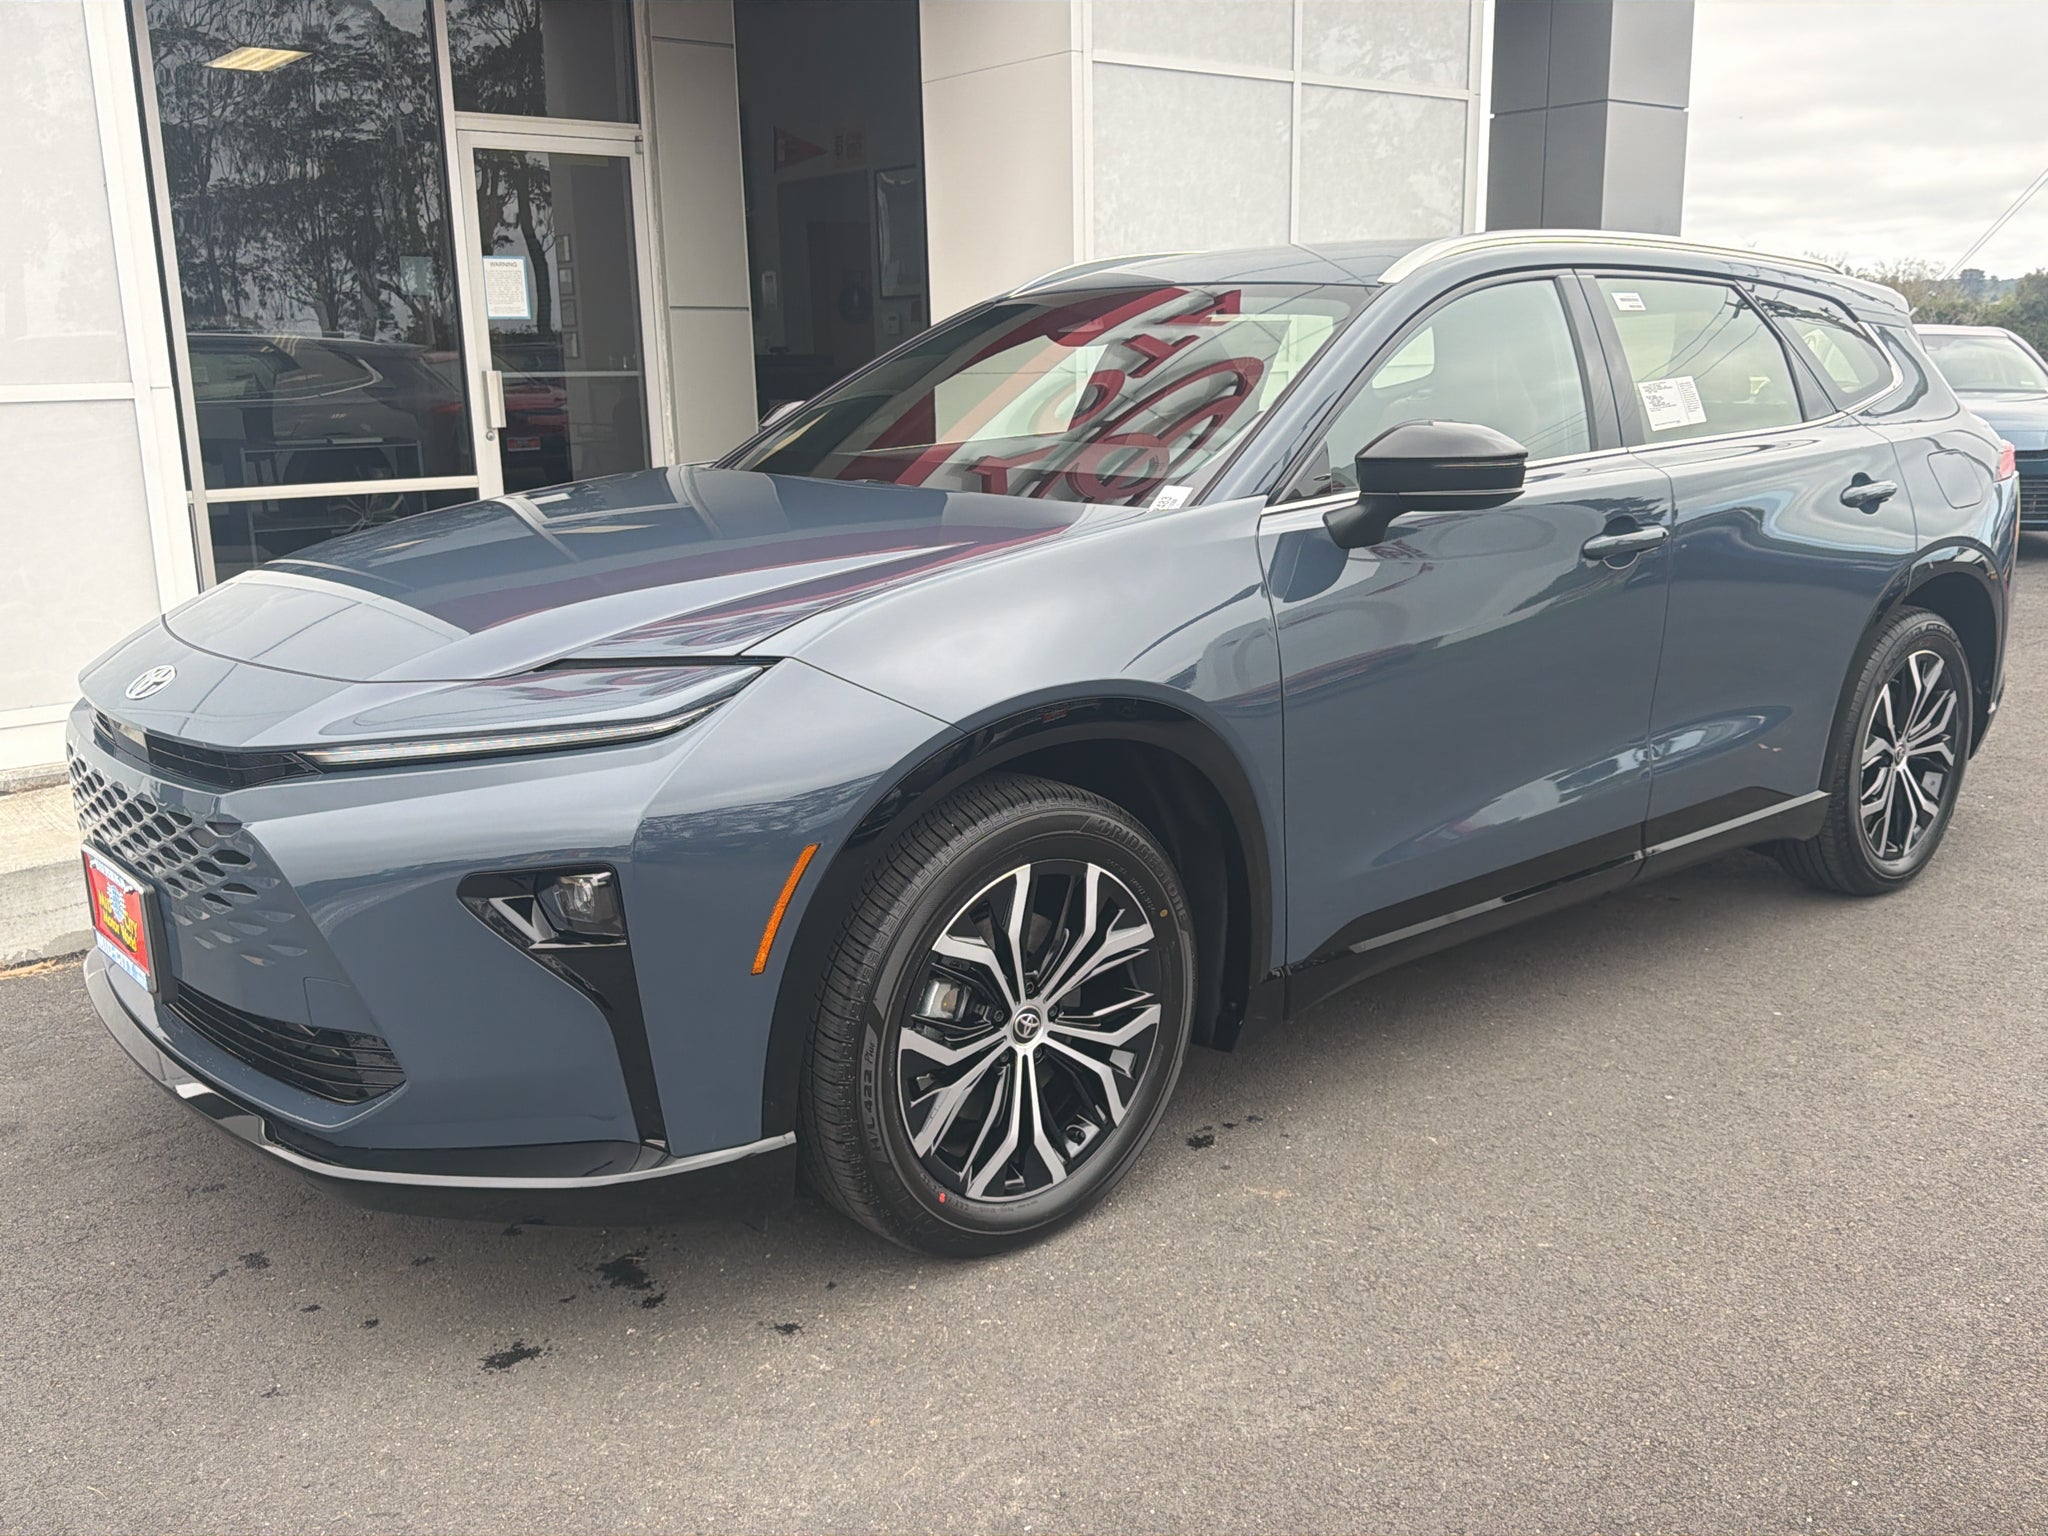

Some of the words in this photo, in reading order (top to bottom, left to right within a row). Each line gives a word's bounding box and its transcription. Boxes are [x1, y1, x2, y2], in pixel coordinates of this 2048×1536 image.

[489, 261, 518, 269] WARNING
[1096, 819, 1187, 922] BRIDGESTONE
[864, 1042, 876, 1065] Plus
[863, 1069, 873, 1113] 422
